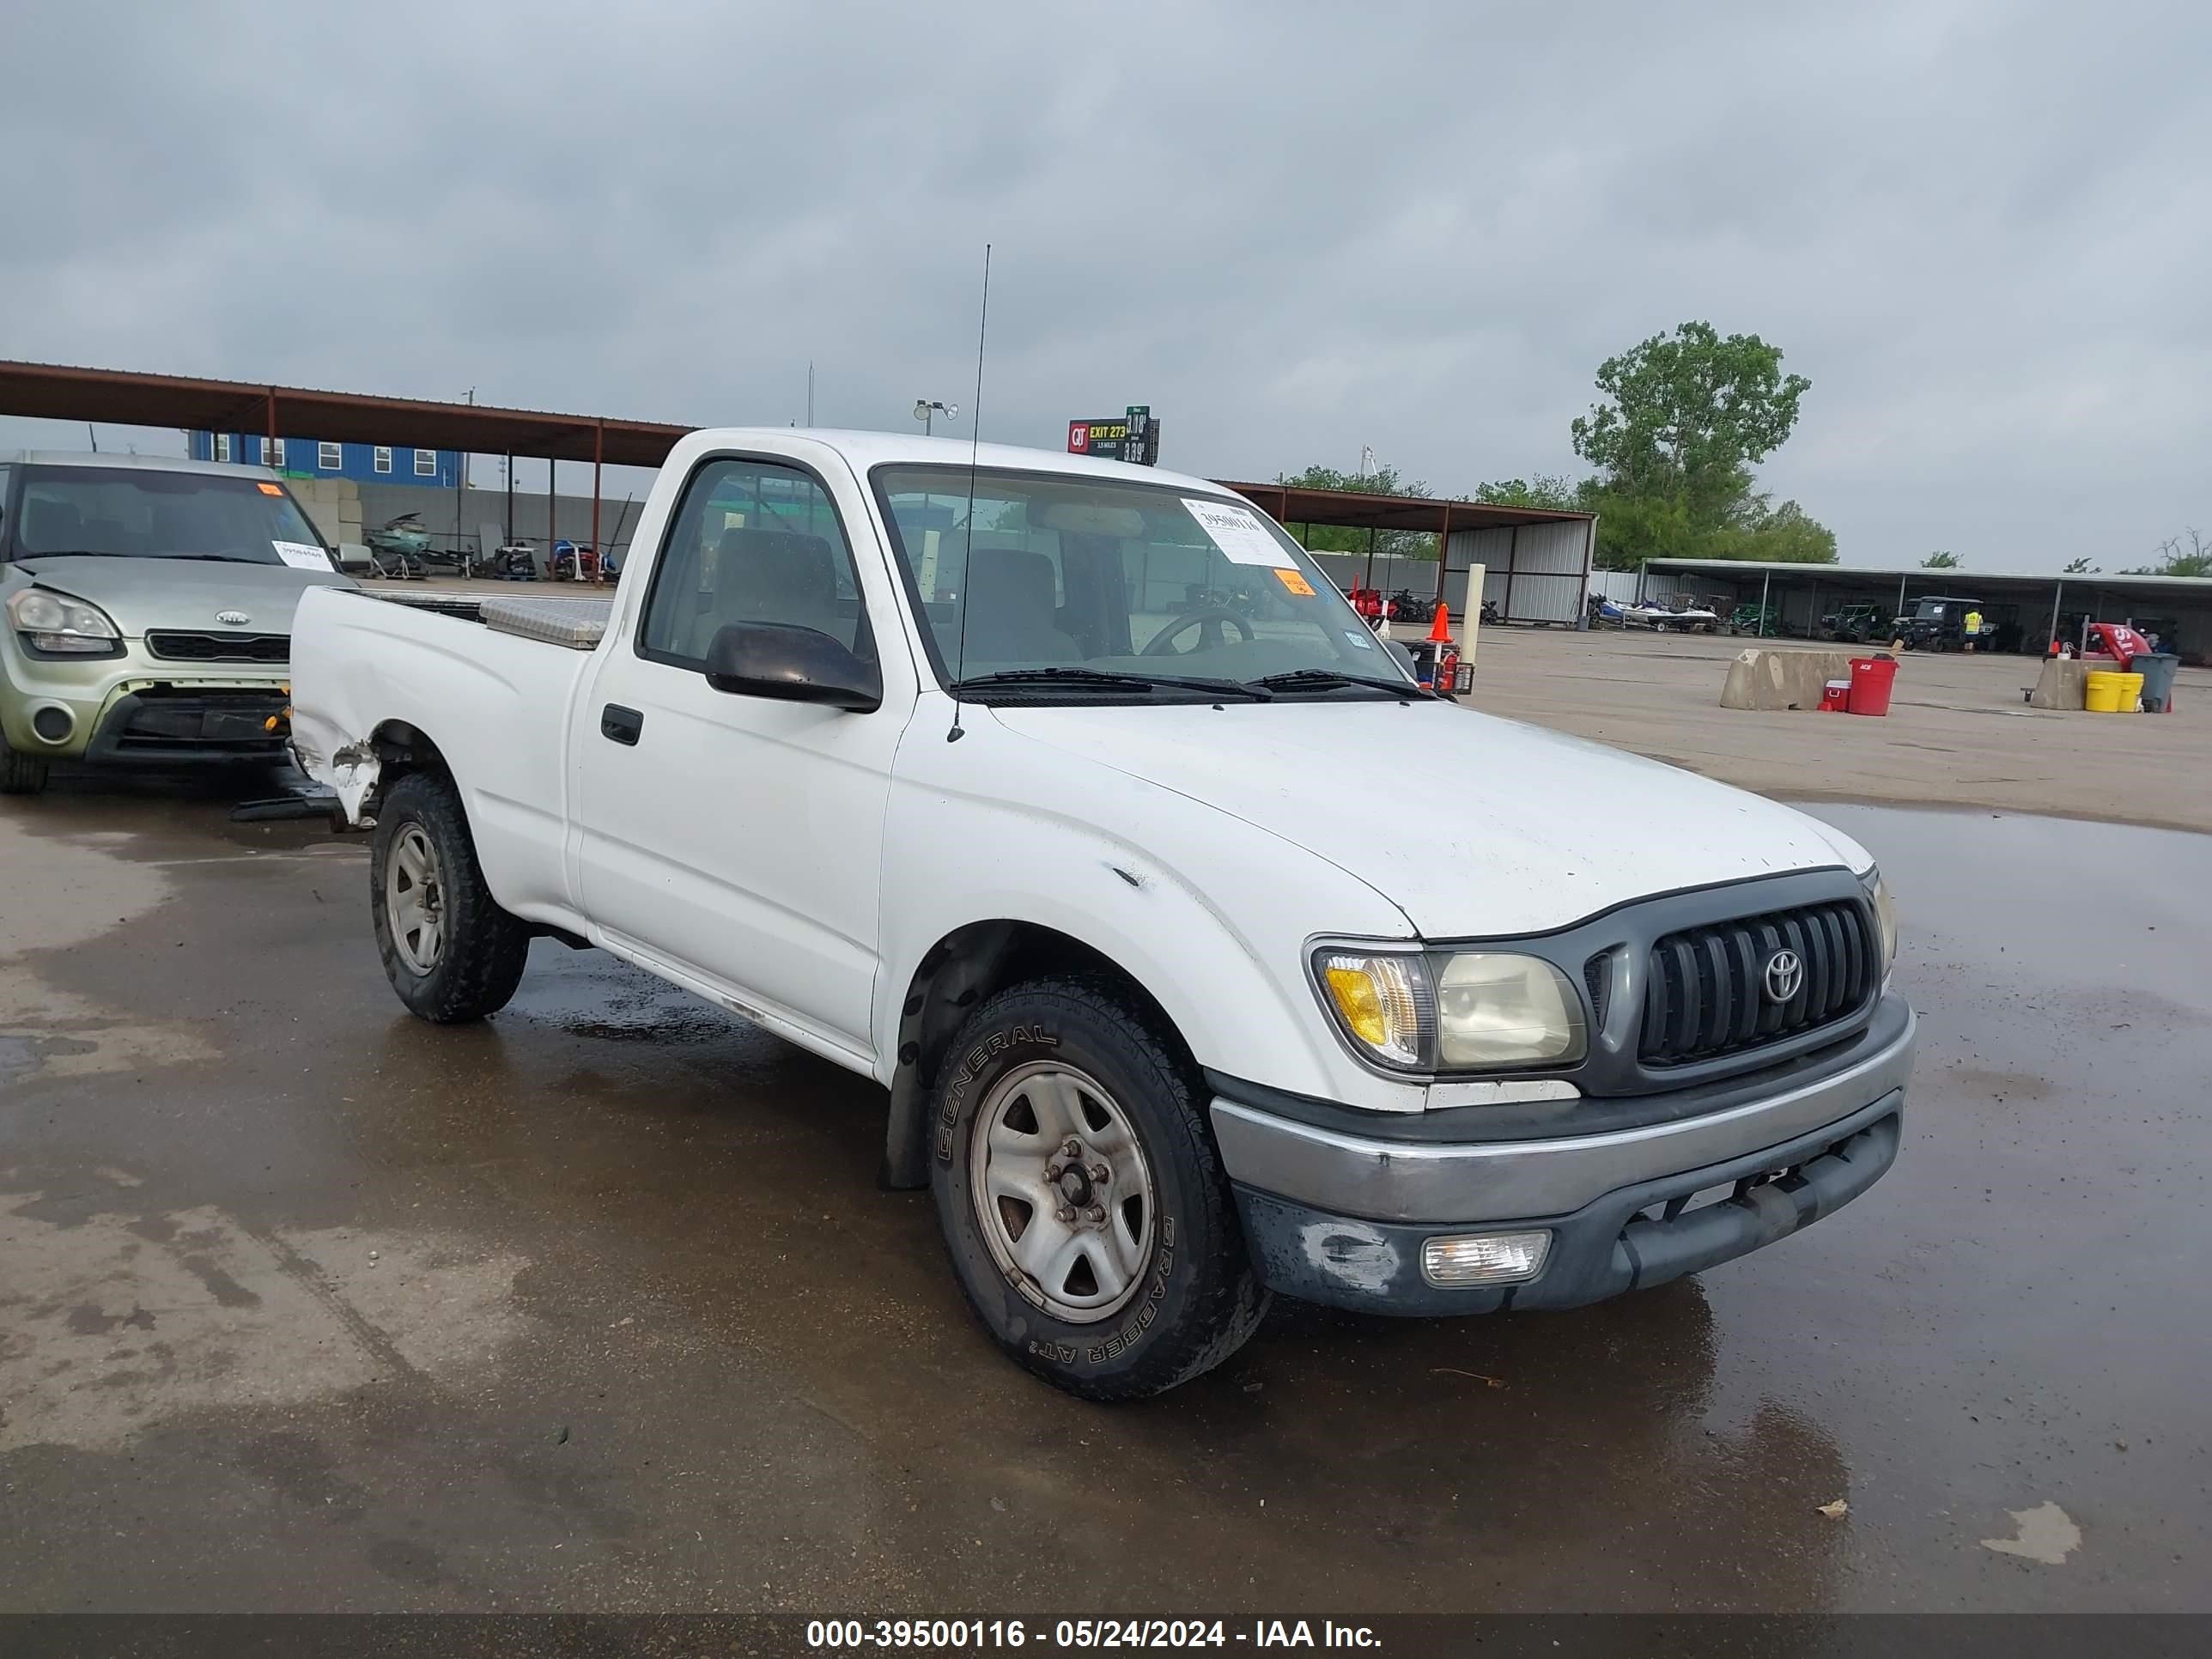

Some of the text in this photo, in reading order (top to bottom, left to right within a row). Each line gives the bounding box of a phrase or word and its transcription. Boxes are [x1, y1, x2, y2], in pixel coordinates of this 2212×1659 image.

[1072, 428, 1086, 447] QT
[1090, 425, 1126, 439] EXIT 273
[1200, 513, 1260, 532] 39500116
[938, 1024, 1057, 1160] GENERAL
[1086, 1215, 1175, 1364] GRABBER
